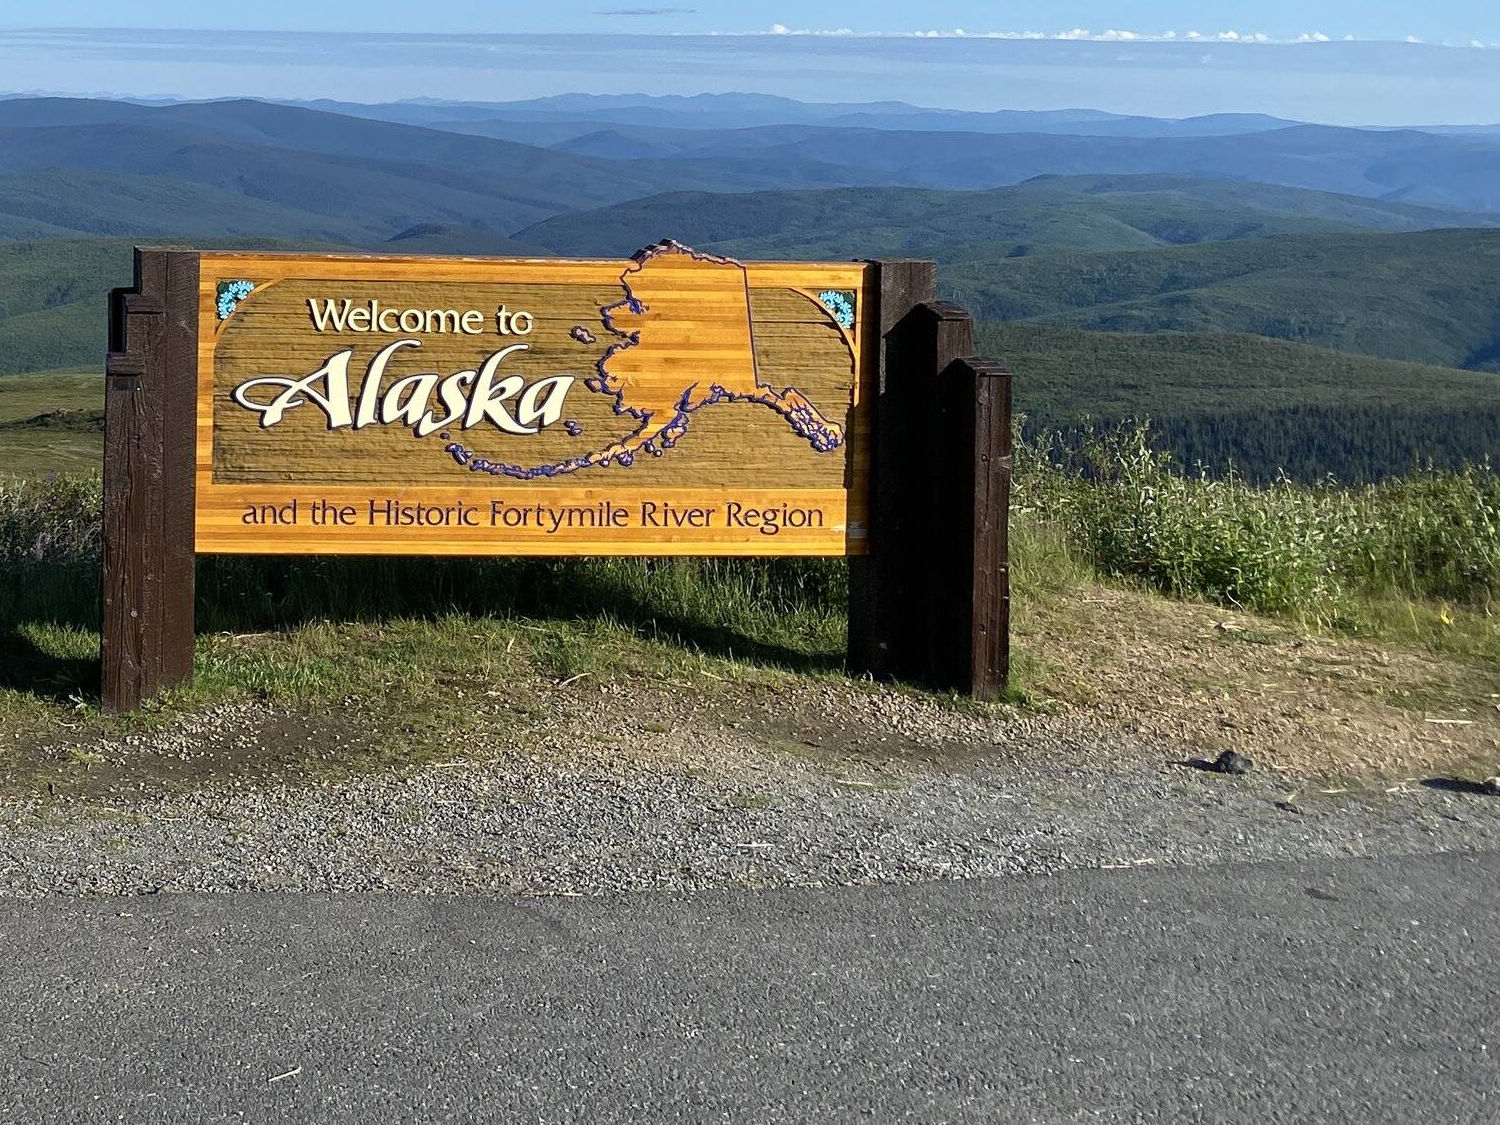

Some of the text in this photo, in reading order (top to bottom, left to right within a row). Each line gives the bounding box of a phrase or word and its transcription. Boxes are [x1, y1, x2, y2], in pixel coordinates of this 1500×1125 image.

[307, 298, 534, 336] Welcome to
[231, 338, 576, 438] Alaska
[242, 498, 824, 535] and the Historic Fortymile River Region
